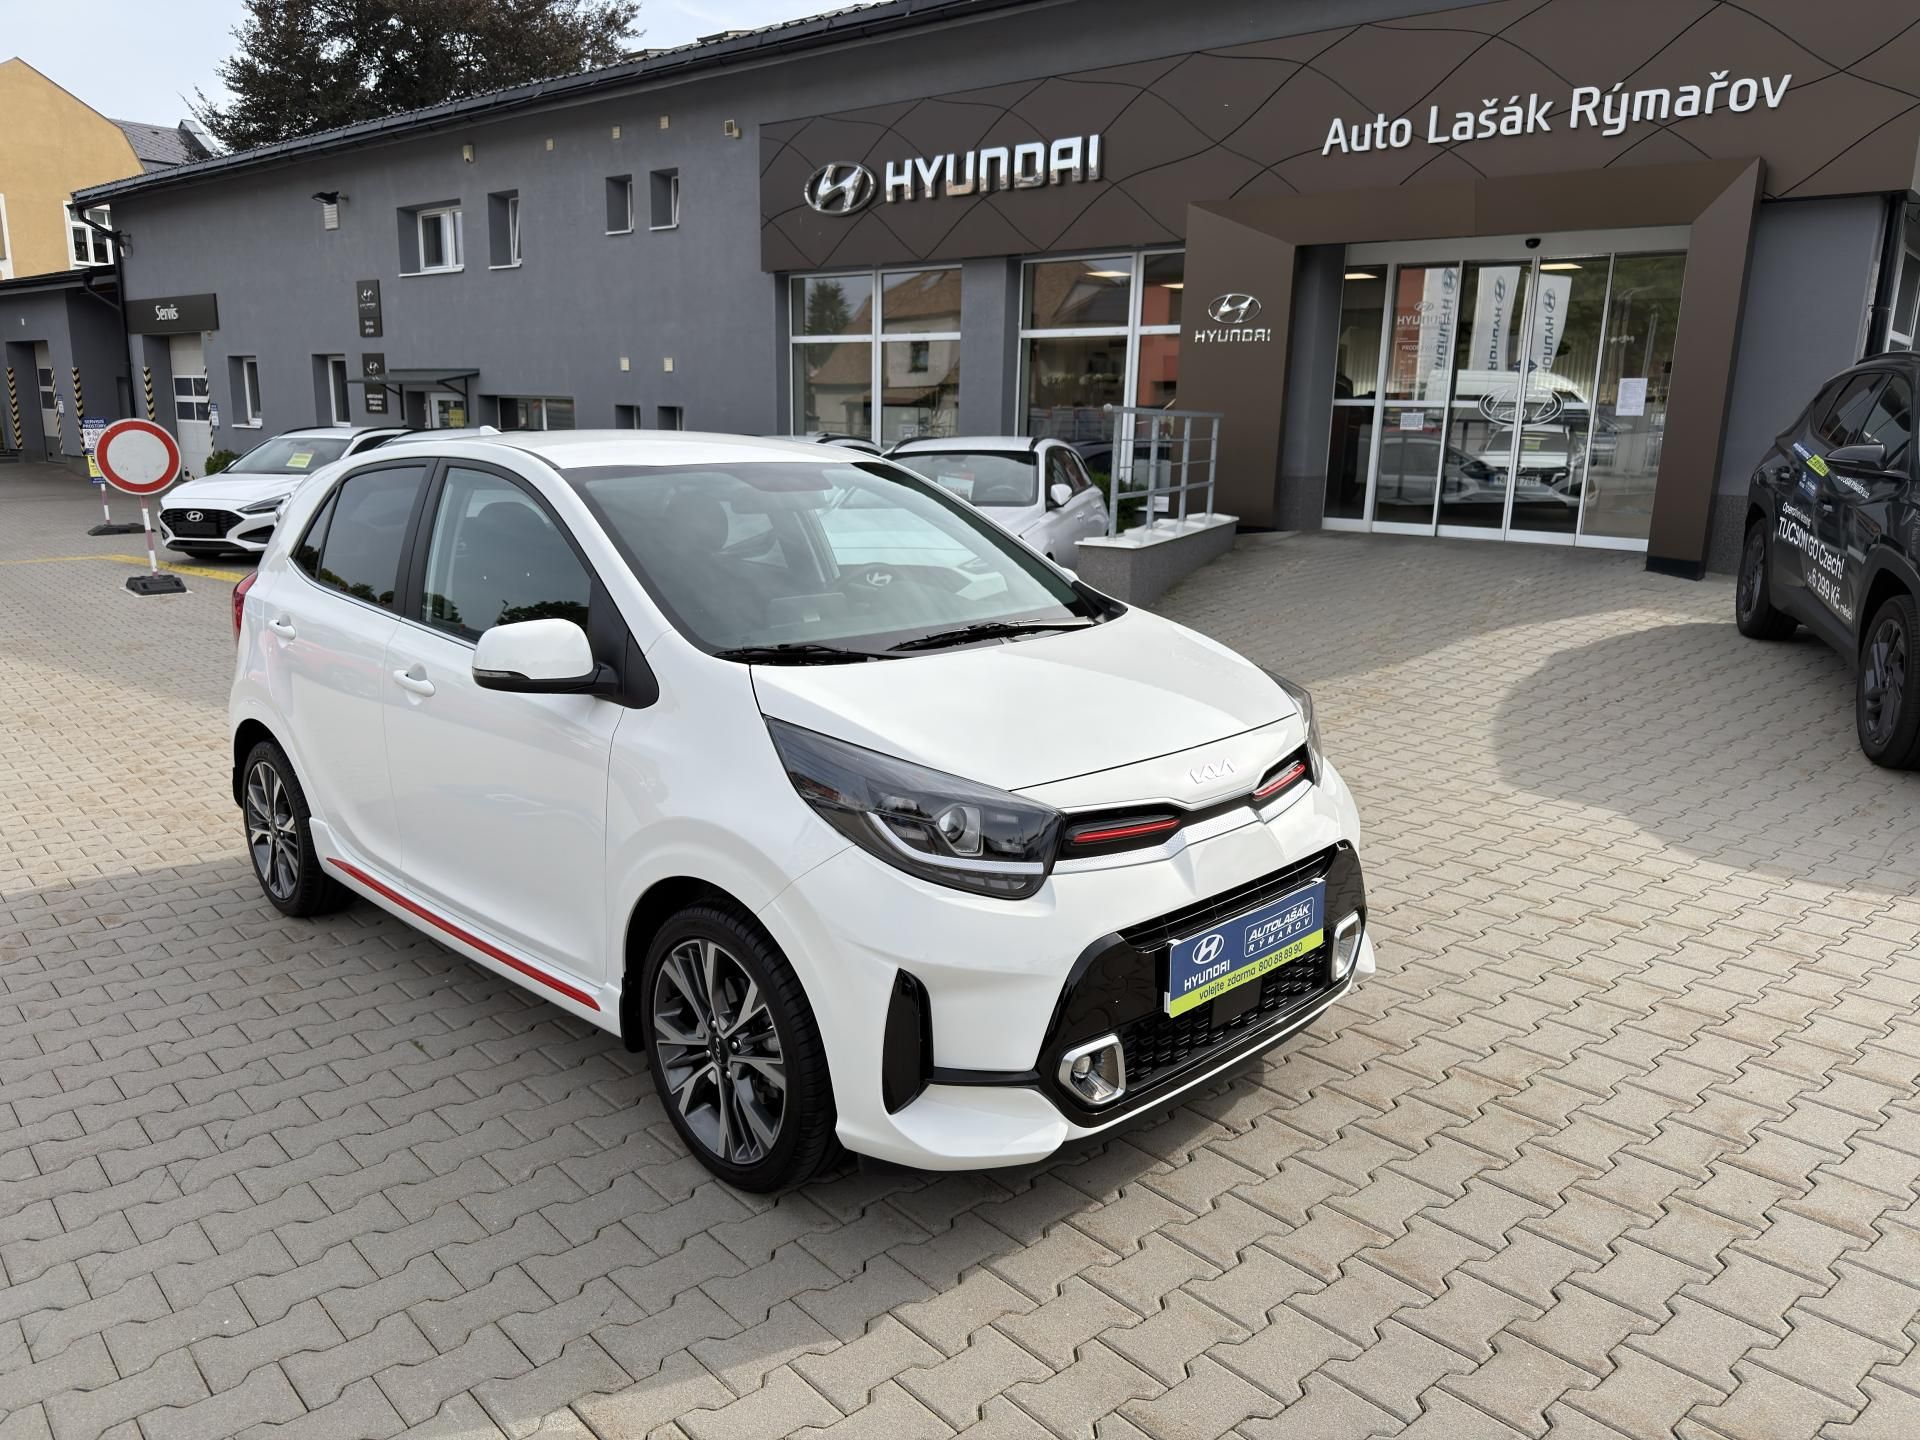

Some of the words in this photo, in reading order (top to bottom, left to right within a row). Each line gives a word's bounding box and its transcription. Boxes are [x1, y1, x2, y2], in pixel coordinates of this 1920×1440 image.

[1321, 112, 1412, 156] Auto
[1428, 92, 1554, 145] Lašák
[1569, 69, 1793, 137] Rýmařov
[885, 133, 1101, 203] HYUNDAI
[155, 303, 179, 321] Servis
[1194, 328, 1271, 343] HYUNDAI
[1487, 307, 1502, 371] HYUNDA
[1778, 516, 1809, 552] TUCSON
[1808, 535, 1819, 560] GO
[1818, 544, 1845, 580] Czech!
[1812, 567, 1817, 587] 6
[1817, 572, 1830, 600] 299
[1830, 583, 1841, 609] Kč
[1248, 903, 1311, 942] AUTOLAŠÁK
[1248, 917, 1310, 953] RÝMAŘOV
[1184, 959, 1230, 991] HYUNDAI
[1199, 981, 1224, 1000] volejte
[1227, 966, 1256, 986] zdarma
[1258, 958, 1273, 972] 800
[1273, 953, 1283, 965] 88
[1283, 948, 1293, 959] 89
[1293, 942, 1303, 954] 90
